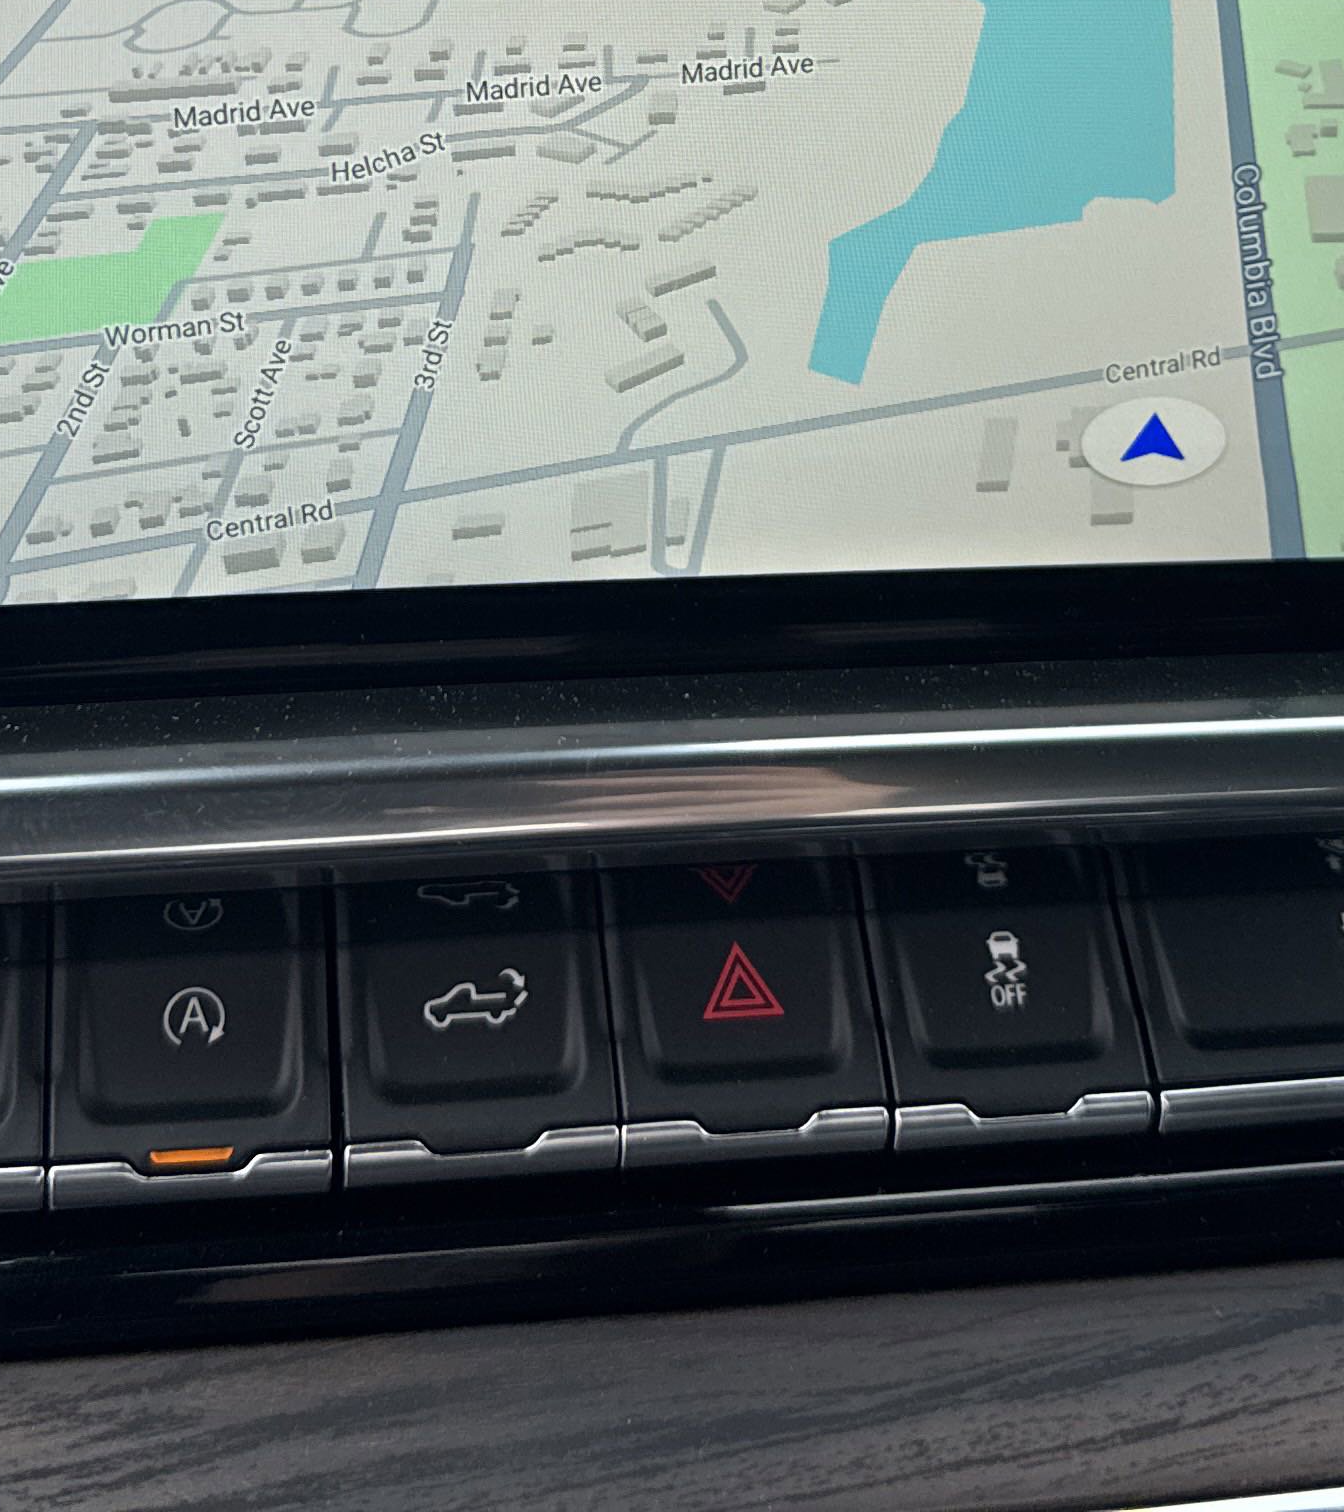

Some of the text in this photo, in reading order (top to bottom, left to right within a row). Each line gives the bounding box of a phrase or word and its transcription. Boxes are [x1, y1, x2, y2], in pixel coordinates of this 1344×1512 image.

[464, 71, 603, 104] Madrid Ave
[680, 52, 815, 86] Madrid Ave
[172, 96, 317, 131] Madrid Ave
[329, 131, 447, 184] Helcha St
[1233, 163, 1284, 380] Columbia Blvd
[103, 310, 246, 347] Worman St
[413, 319, 454, 389] 3rd St
[1105, 345, 1222, 385] Central Rd
[55, 361, 111, 438] 2nd St
[234, 338, 293, 449] Scott Ave
[206, 499, 335, 541] Central Rd
[990, 982, 1028, 1008] OFF
